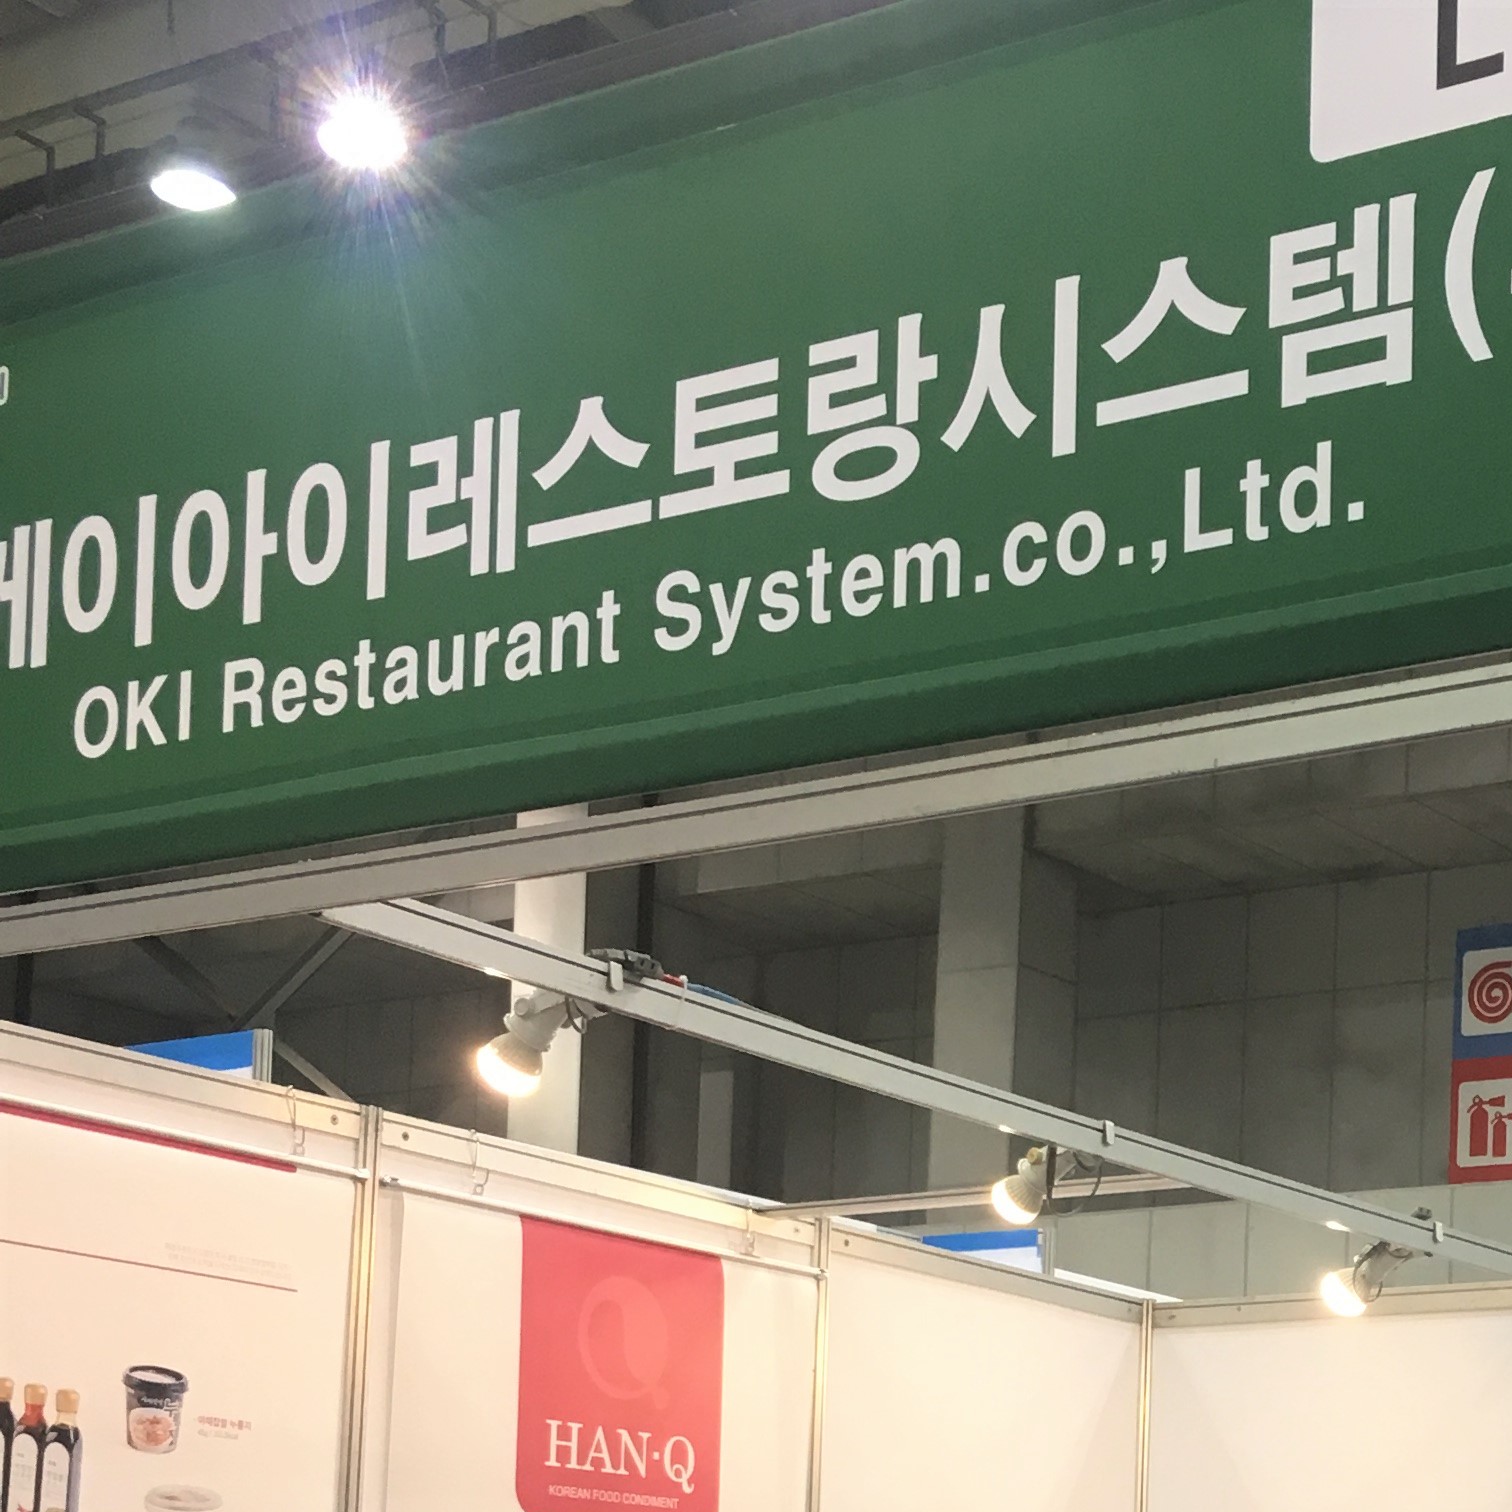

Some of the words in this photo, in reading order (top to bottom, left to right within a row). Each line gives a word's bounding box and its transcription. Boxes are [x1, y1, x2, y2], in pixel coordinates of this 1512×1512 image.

[73, 670, 191, 759] OKI
[222, 590, 621, 733] Restaurant
[548, 1485, 591, 1500] KOREAN
[592, 1489, 620, 1503] FOOD
[622, 1492, 679, 1509] CONDIMENT
